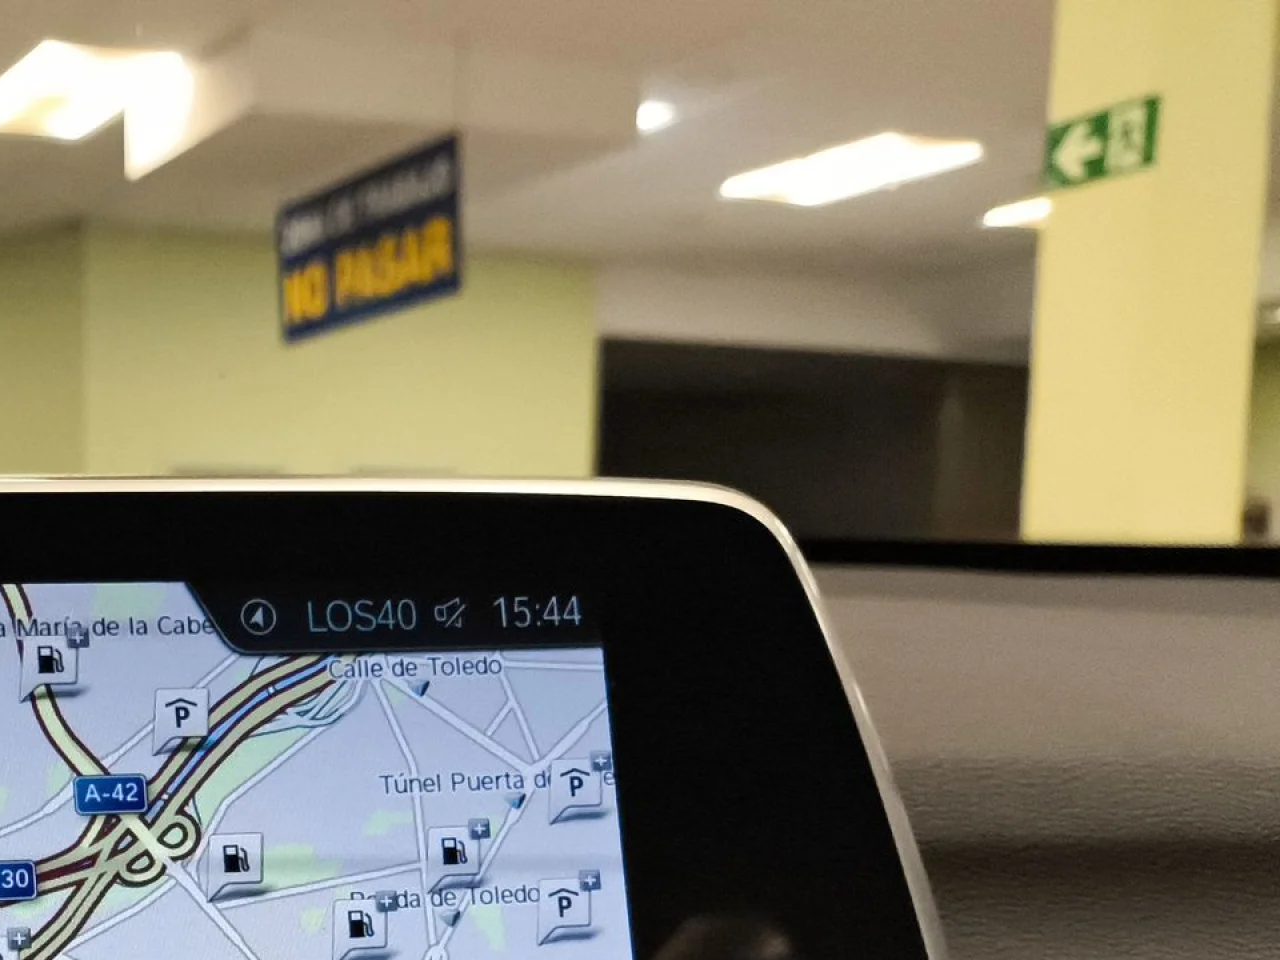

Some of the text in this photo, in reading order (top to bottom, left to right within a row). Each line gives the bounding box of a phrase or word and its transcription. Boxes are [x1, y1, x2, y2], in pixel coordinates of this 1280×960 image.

[307, 598, 417, 633] LOS40
[493, 595, 583, 629] 15:44
[92, 616, 120, 636] de
[129, 616, 148, 636] la
[327, 655, 502, 680] Calle de Toledo
[84, 783, 139, 804] A-42
[379, 771, 441, 795] Túnel
[451, 770, 525, 793] Puerta
[430, 888, 457, 908] de
[466, 883, 540, 905] Toledo
